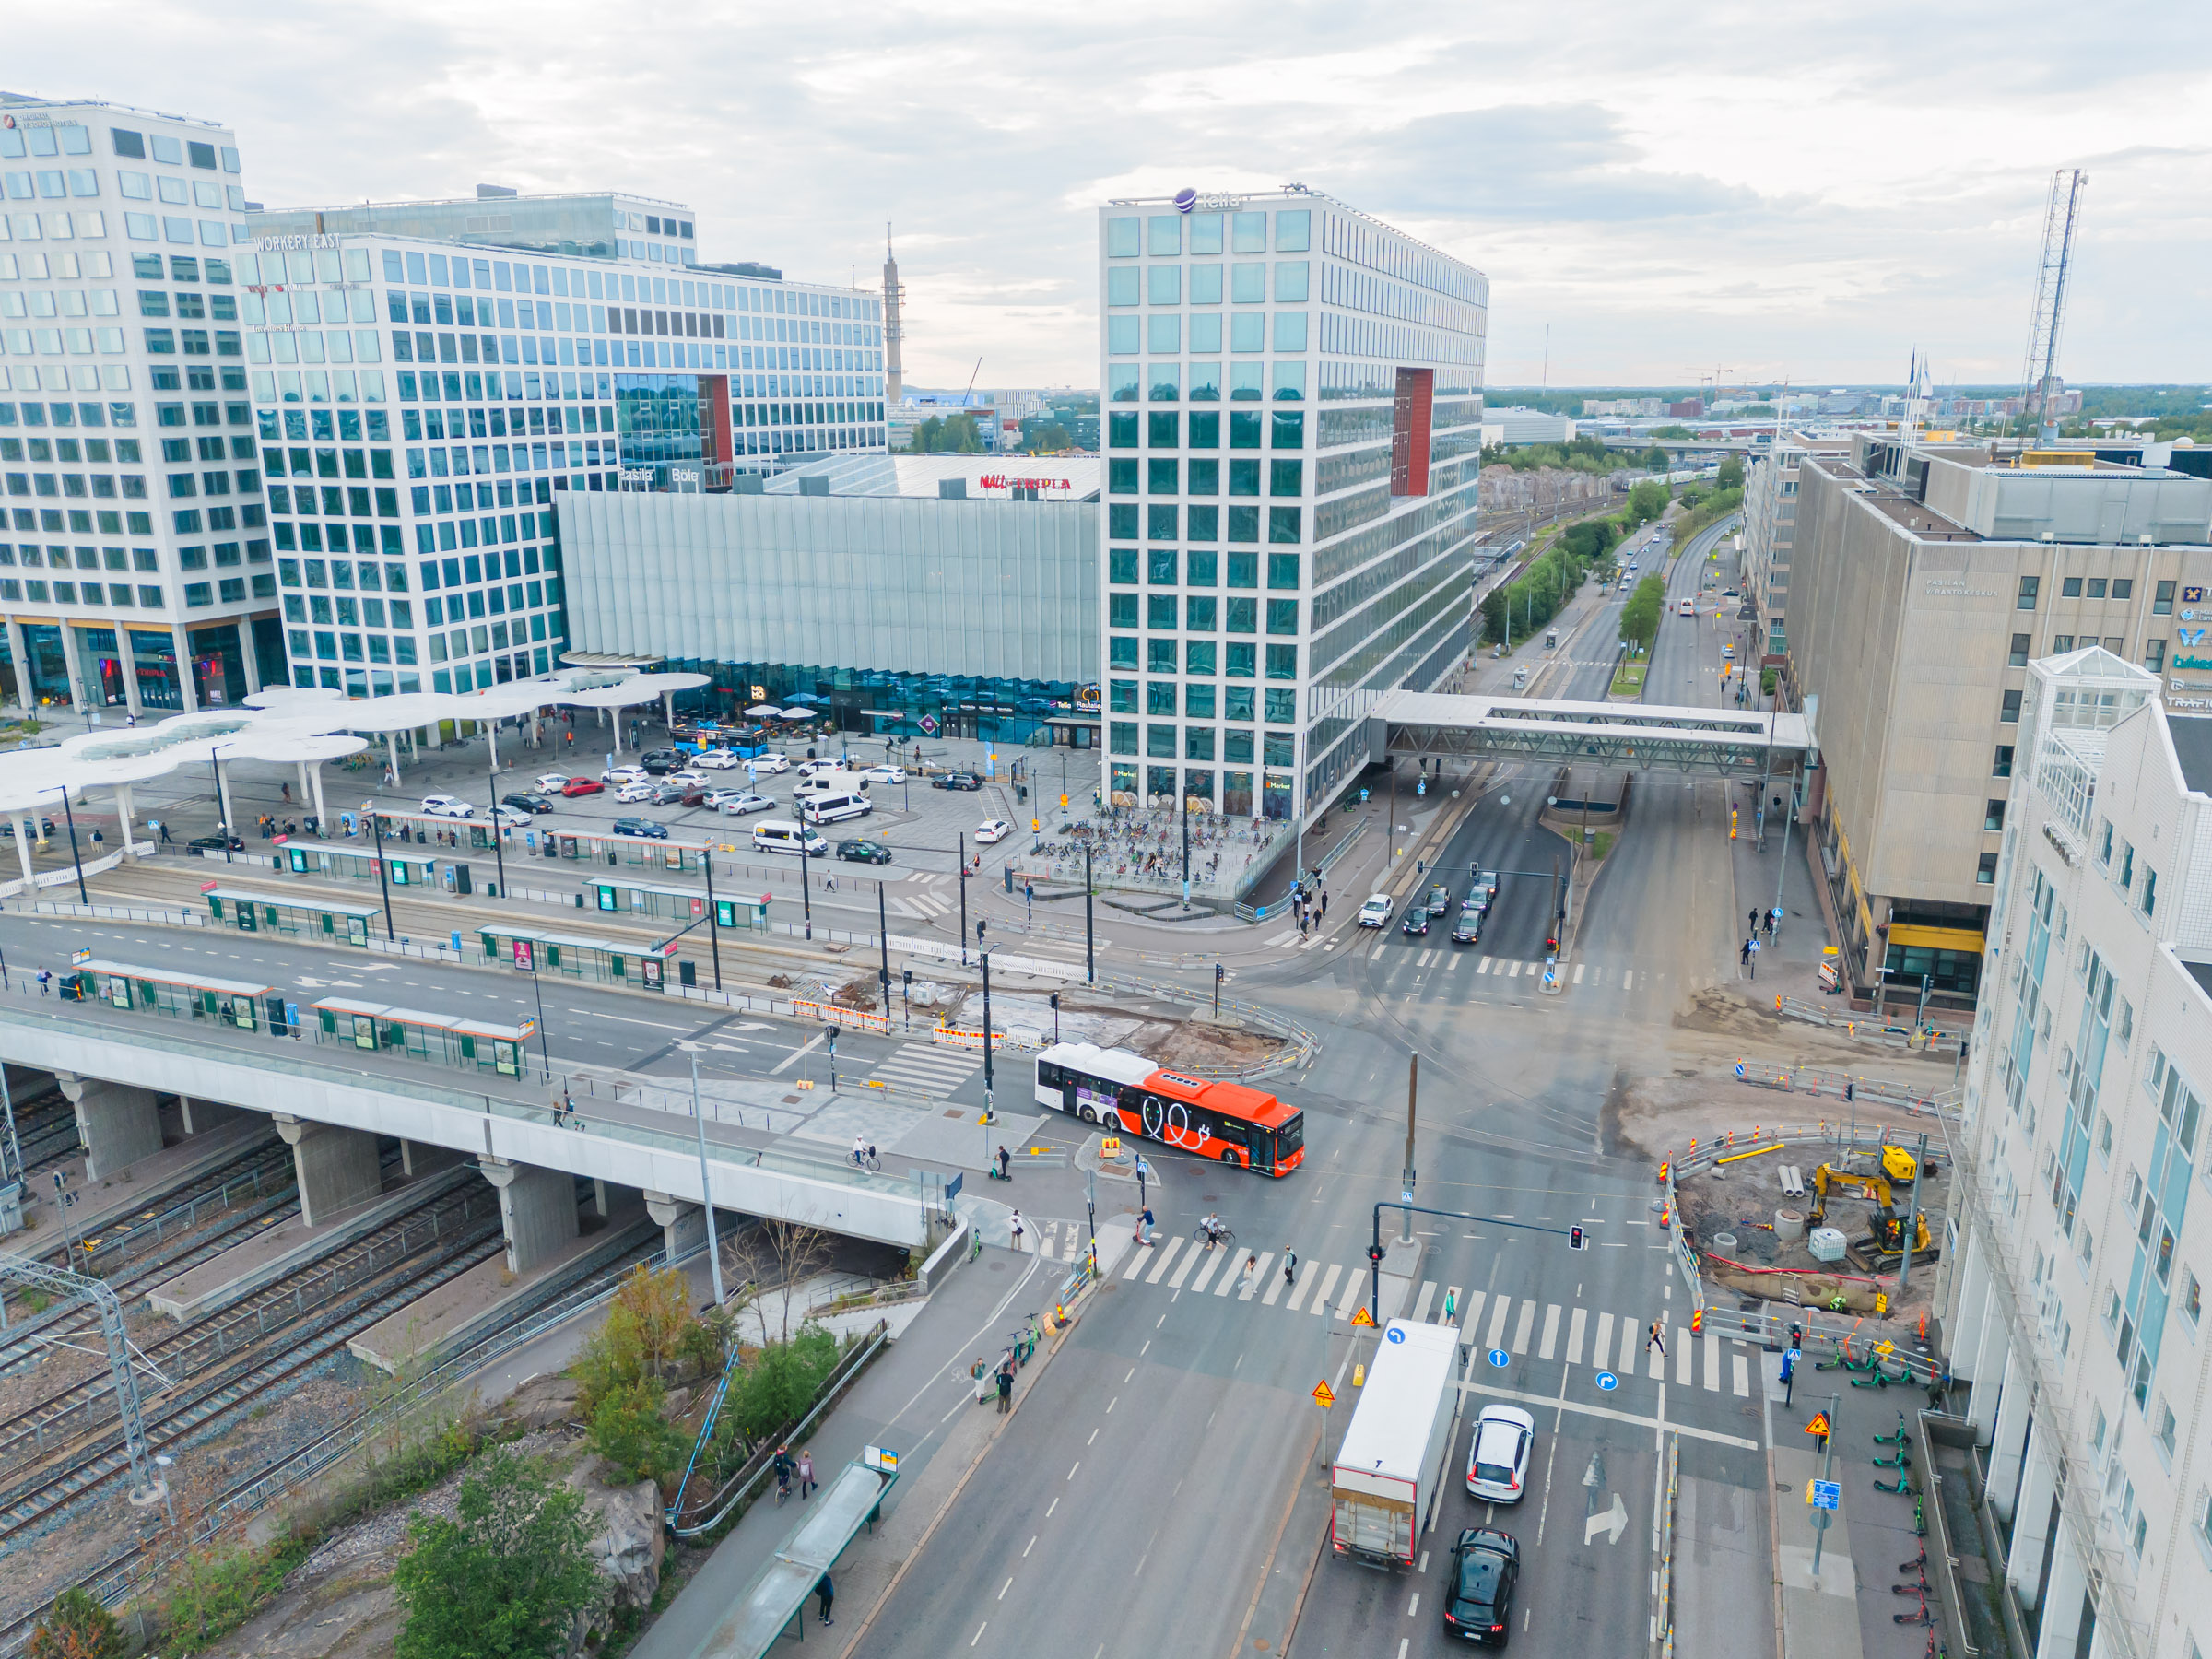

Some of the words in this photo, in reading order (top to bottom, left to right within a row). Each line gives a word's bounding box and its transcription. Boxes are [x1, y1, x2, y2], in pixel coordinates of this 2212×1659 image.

[1199, 192, 1241, 209] Telia
[254, 234, 309, 252] WORKERY
[314, 232, 341, 249] EAST
[618, 467, 653, 482] Pasila
[671, 467, 700, 482] Böle
[1015, 477, 1072, 490] TRIPLA
[1926, 588, 1998, 597] VIRASTOKESKUS
